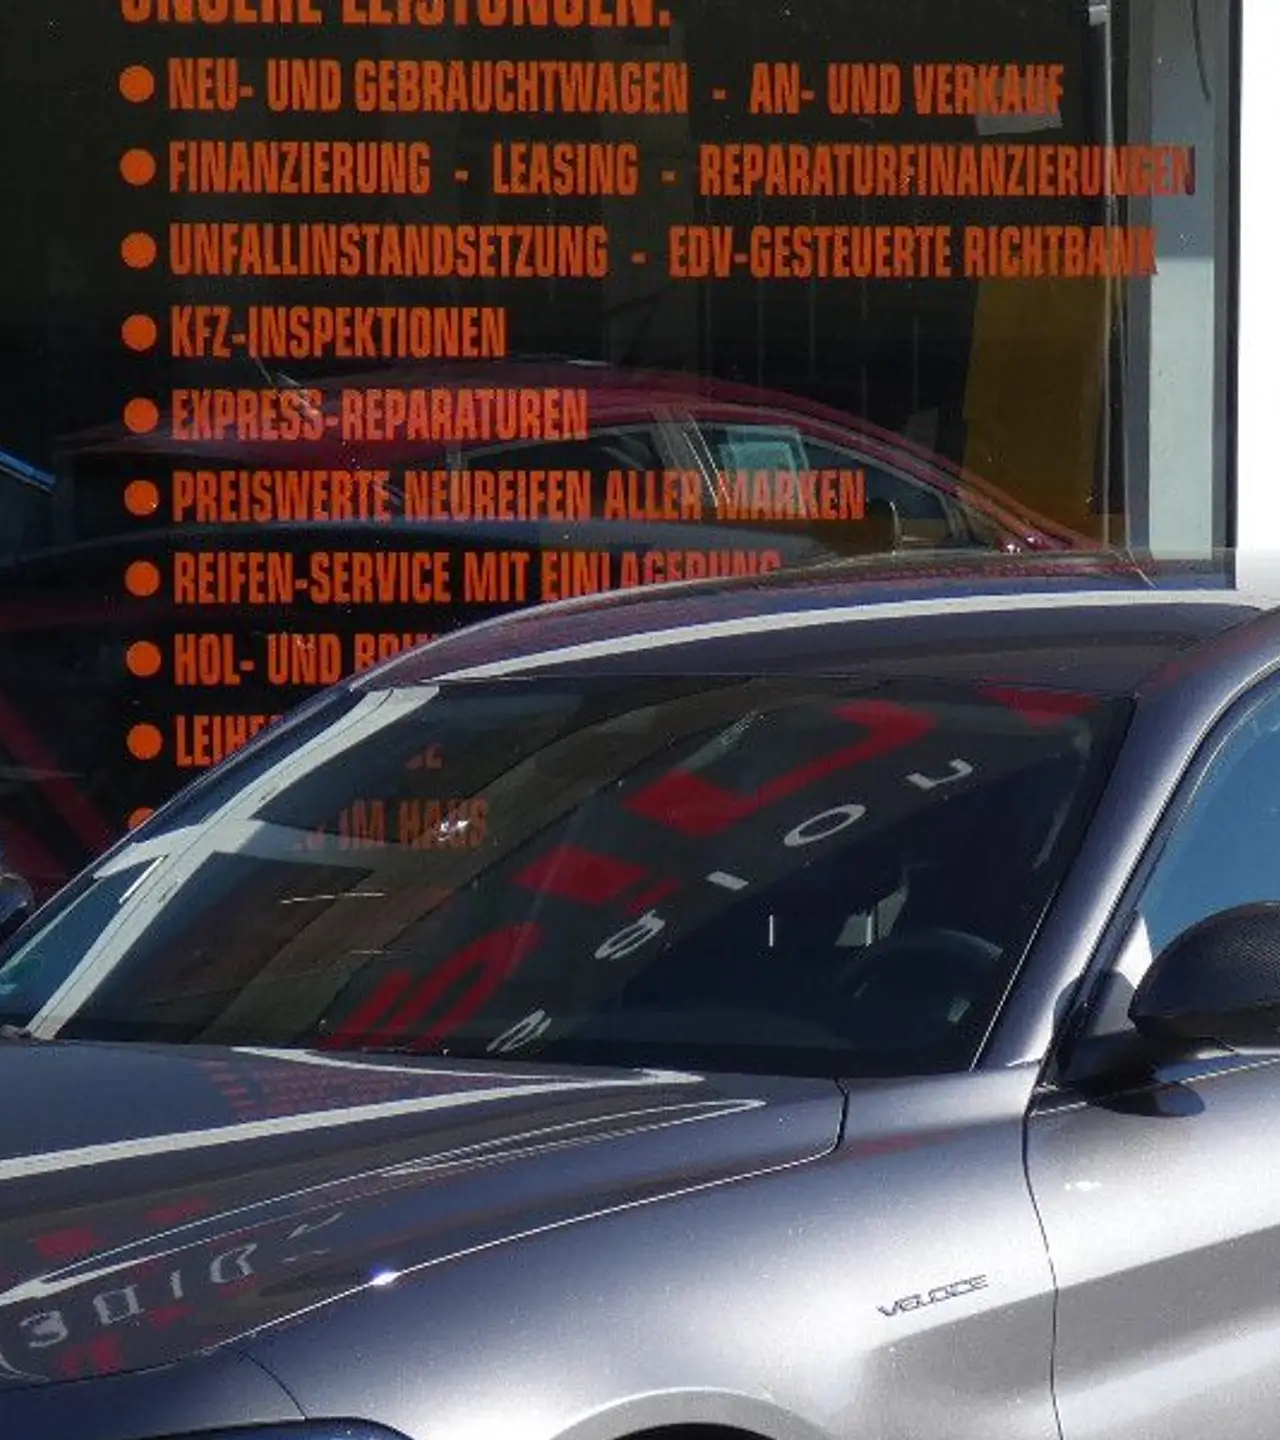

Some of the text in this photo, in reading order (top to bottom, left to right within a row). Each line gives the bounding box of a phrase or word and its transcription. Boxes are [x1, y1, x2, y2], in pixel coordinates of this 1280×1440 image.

[170, 58, 252, 110] NEU-
[267, 60, 340, 111] UND
[355, 61, 688, 113] GEBRAUCHTWAGEN
[750, 63, 814, 114] AN-
[828, 64, 900, 114] UND
[914, 64, 1064, 115] VERKAUF
[169, 142, 430, 194] FINANZIERUNG
[493, 144, 638, 195] LEASING
[700, 145, 1195, 196] REPARATURFINANZIERUNGEN
[170, 223, 607, 277] UNFALLINSTANDSETZUNG
[670, 226, 950, 278] EDV-GESTEUERTE
[965, 226, 1157, 278] RICHTBANK
[171, 306, 506, 358] KFZ-INSPEKTIONEN
[172, 388, 589, 441] EXPRESS-REPARATUREN
[173, 470, 864, 522] PREISWERTE NEUREIFEN ALLER MARKEN
[174, 552, 450, 604] REIFEN-SERVICE
[464, 552, 530, 602] MIT
[175, 634, 255, 685] HOL-
[268, 634, 341, 685] UND
[876, 1274, 989, 1316] VELOCE
